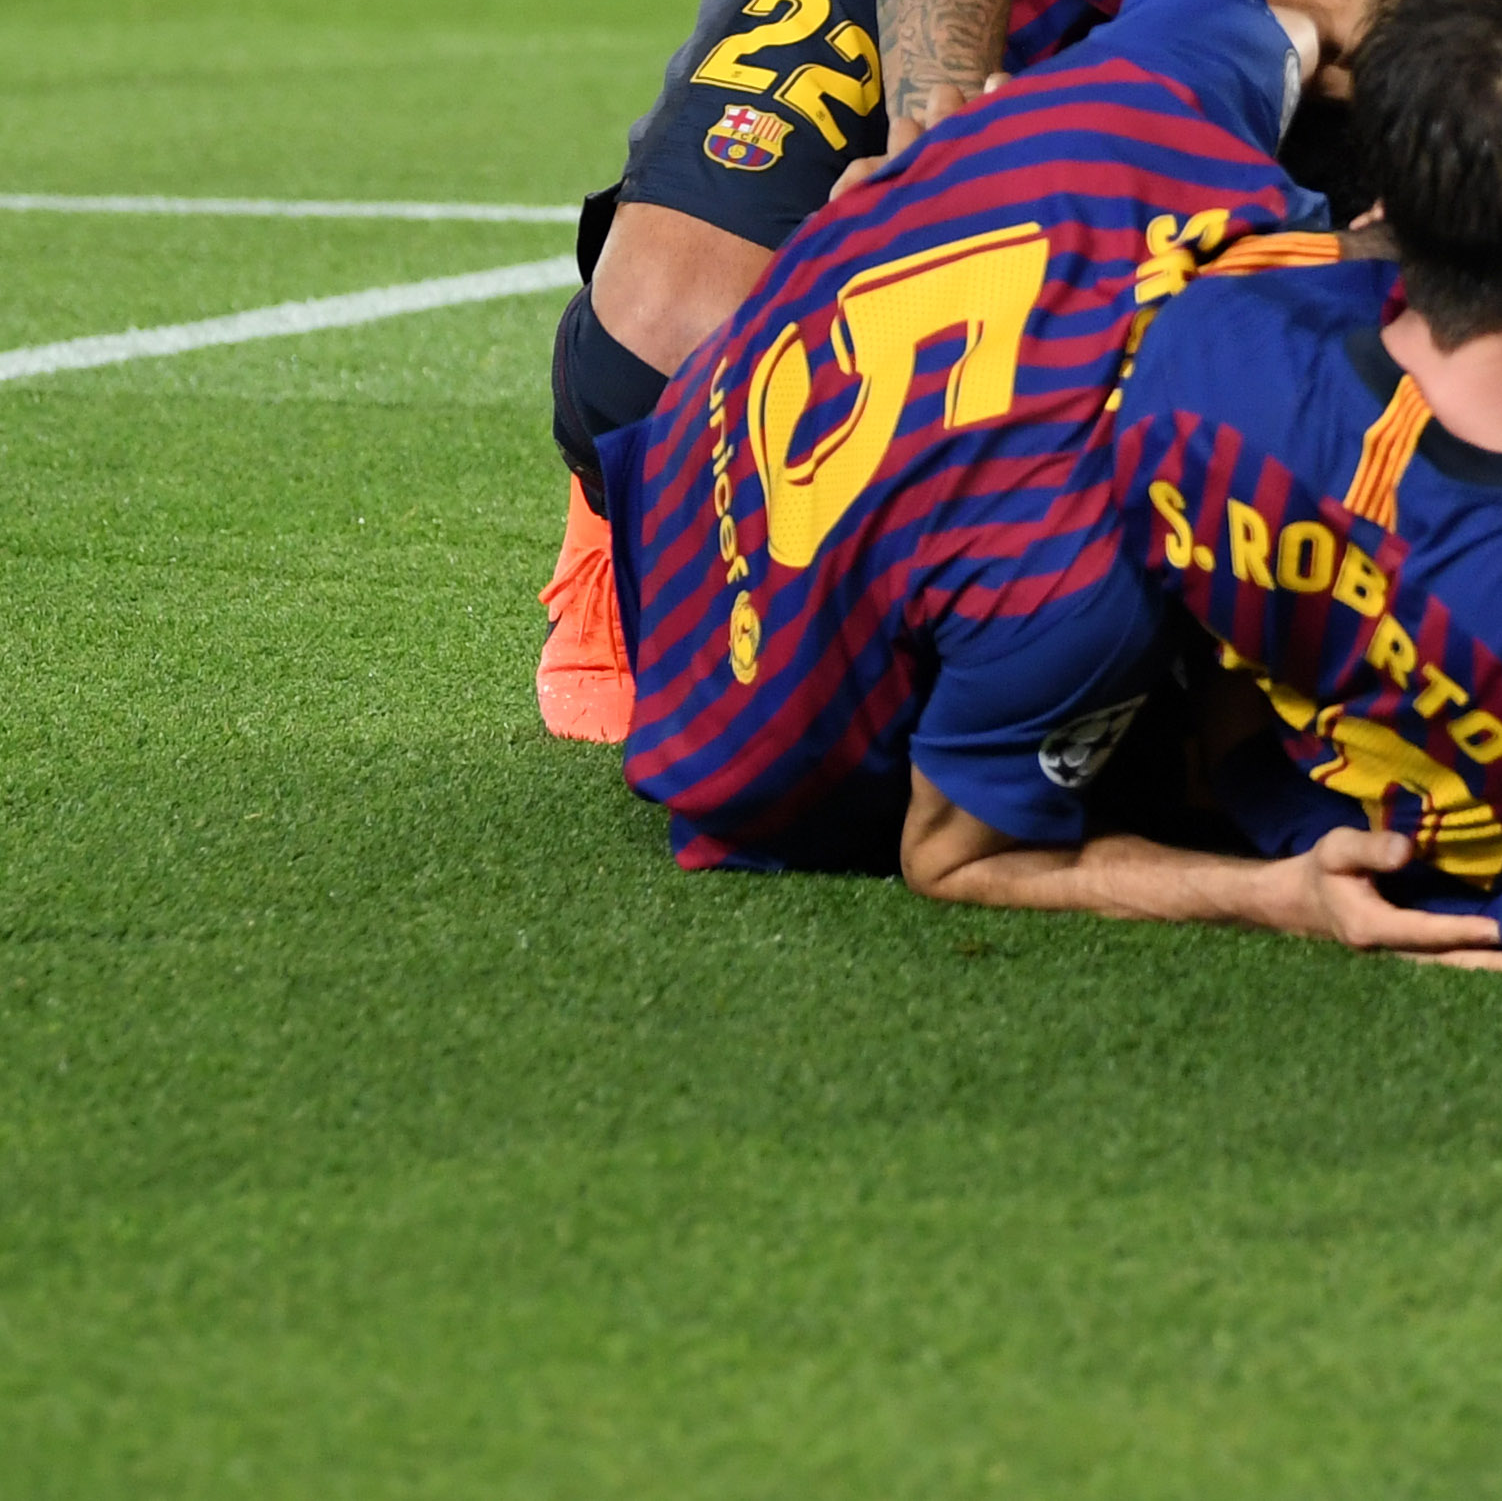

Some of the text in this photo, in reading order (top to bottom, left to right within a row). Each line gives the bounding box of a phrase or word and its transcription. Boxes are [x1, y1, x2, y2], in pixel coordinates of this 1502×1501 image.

[709, 356, 749, 585] unicef
[747, 222, 1050, 568] 5
[1148, 480, 1216, 572] S.
